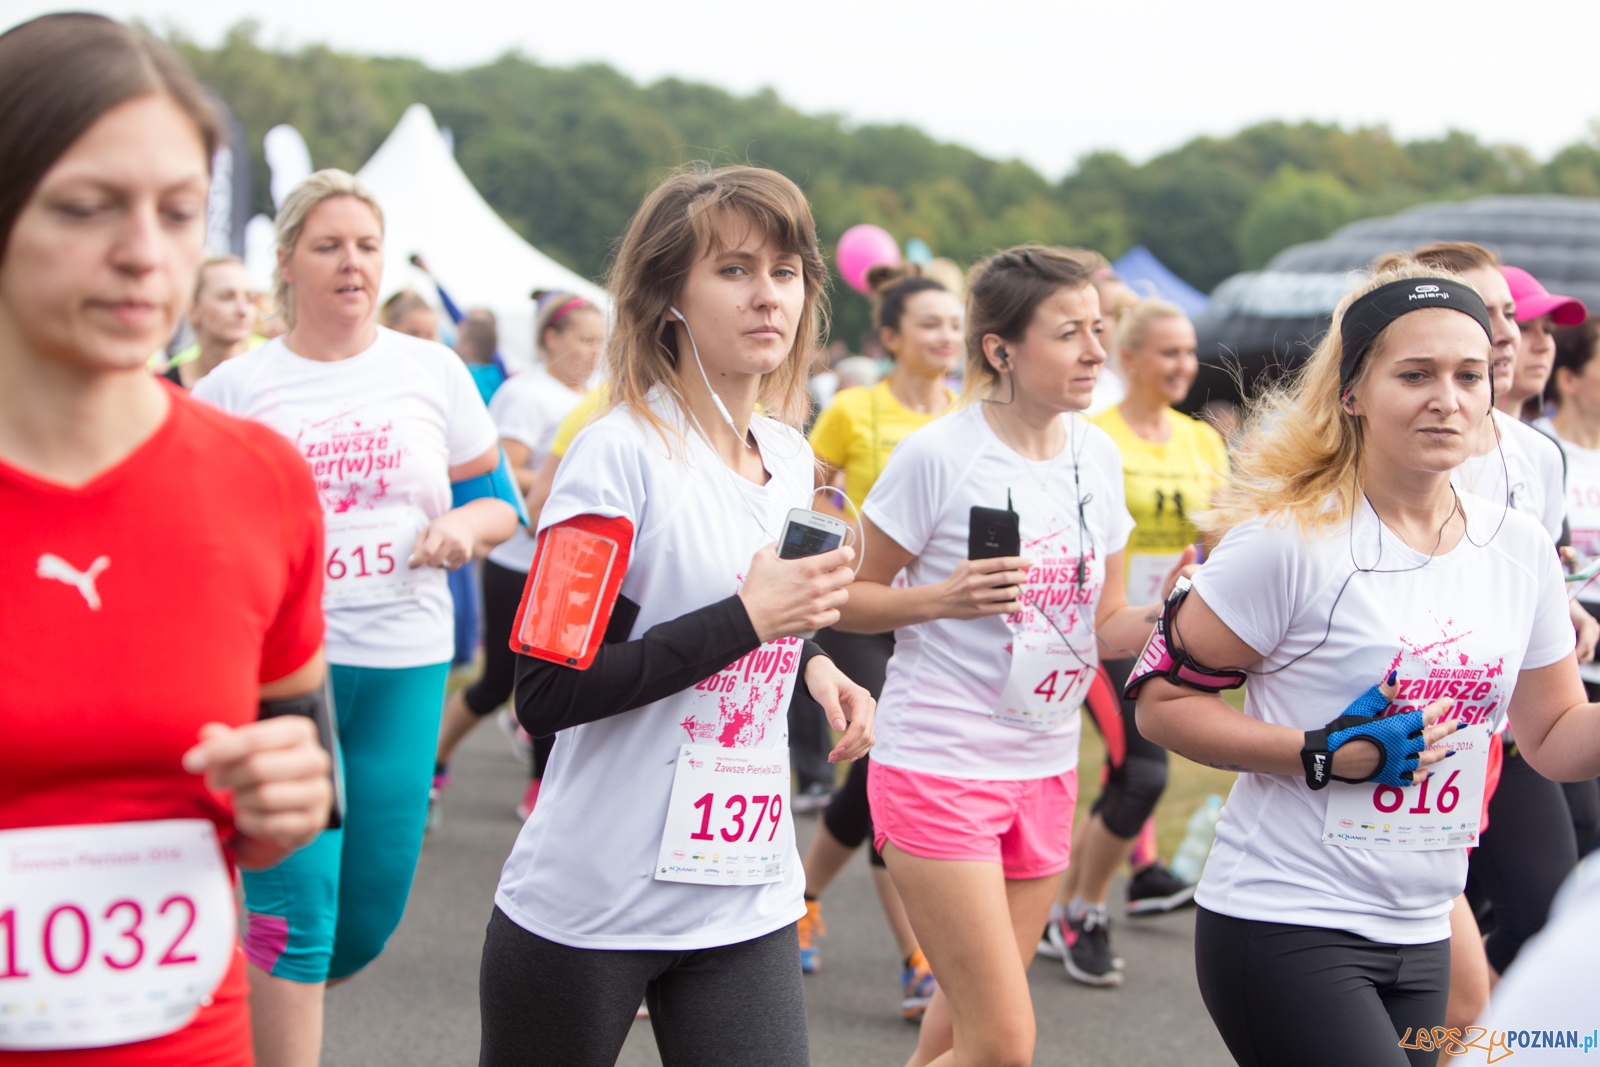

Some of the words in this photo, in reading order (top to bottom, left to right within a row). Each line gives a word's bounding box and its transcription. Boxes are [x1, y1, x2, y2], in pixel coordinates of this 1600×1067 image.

[1408, 292, 1449, 301] Kalenji
[306, 436, 388, 458] zawsze
[326, 542, 395, 580] 615
[695, 674, 738, 693] 2016
[1034, 664, 1090, 703] 479
[1429, 668, 1451, 679] BIEG
[1451, 668, 1484, 680] KOBIET
[1394, 679, 1493, 702] zawsze
[1456, 741, 1474, 751] 2016
[714, 762, 745, 774] Zawsze
[690, 793, 782, 843] 1379
[0, 895, 198, 979] 1032
